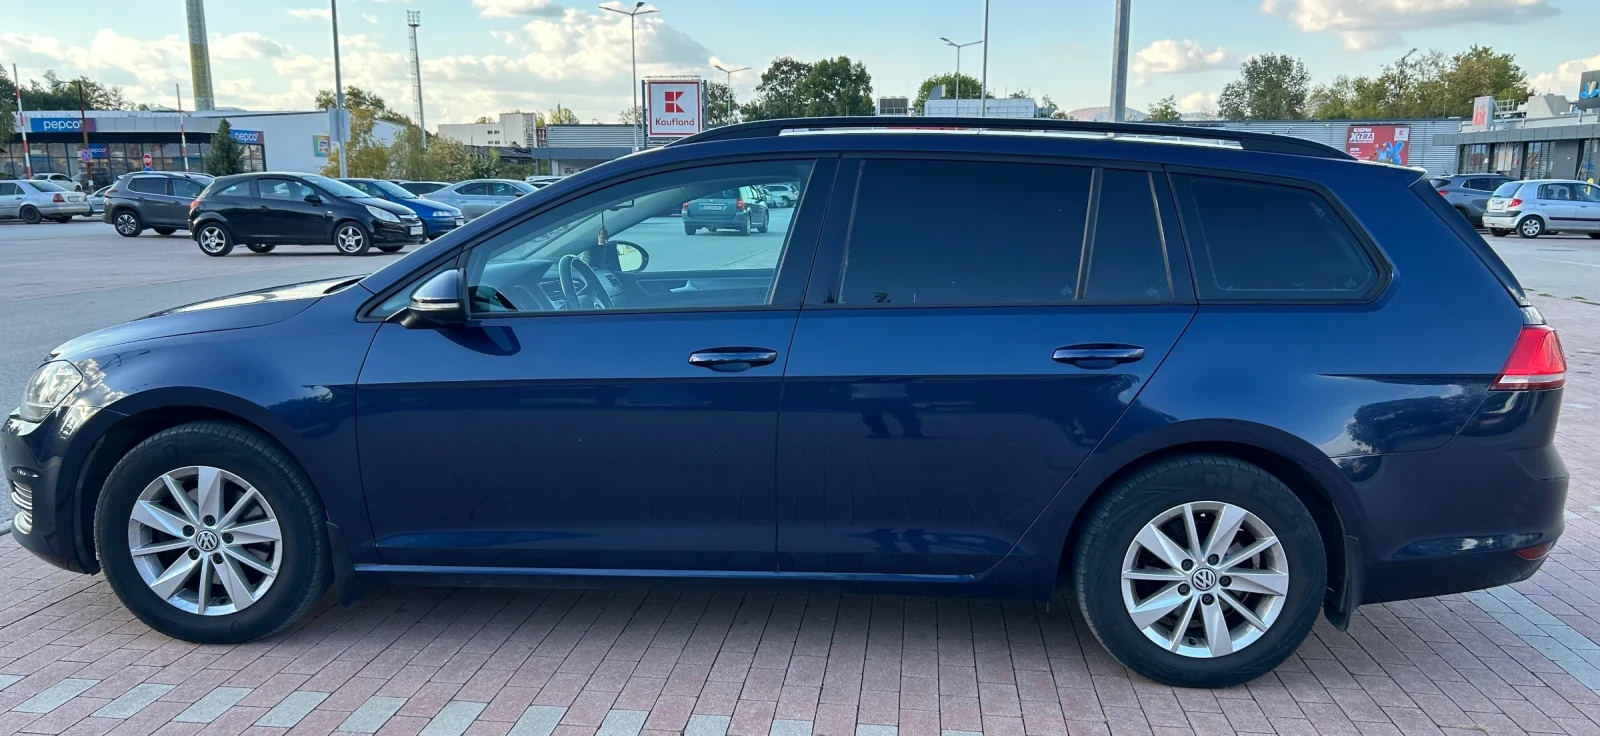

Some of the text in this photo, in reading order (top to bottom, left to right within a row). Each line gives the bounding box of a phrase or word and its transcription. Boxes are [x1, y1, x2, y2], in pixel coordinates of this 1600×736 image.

[43, 120, 80, 131] pepco
[655, 117, 695, 126] Kaufland
[1350, 132, 1375, 141] XTRA
